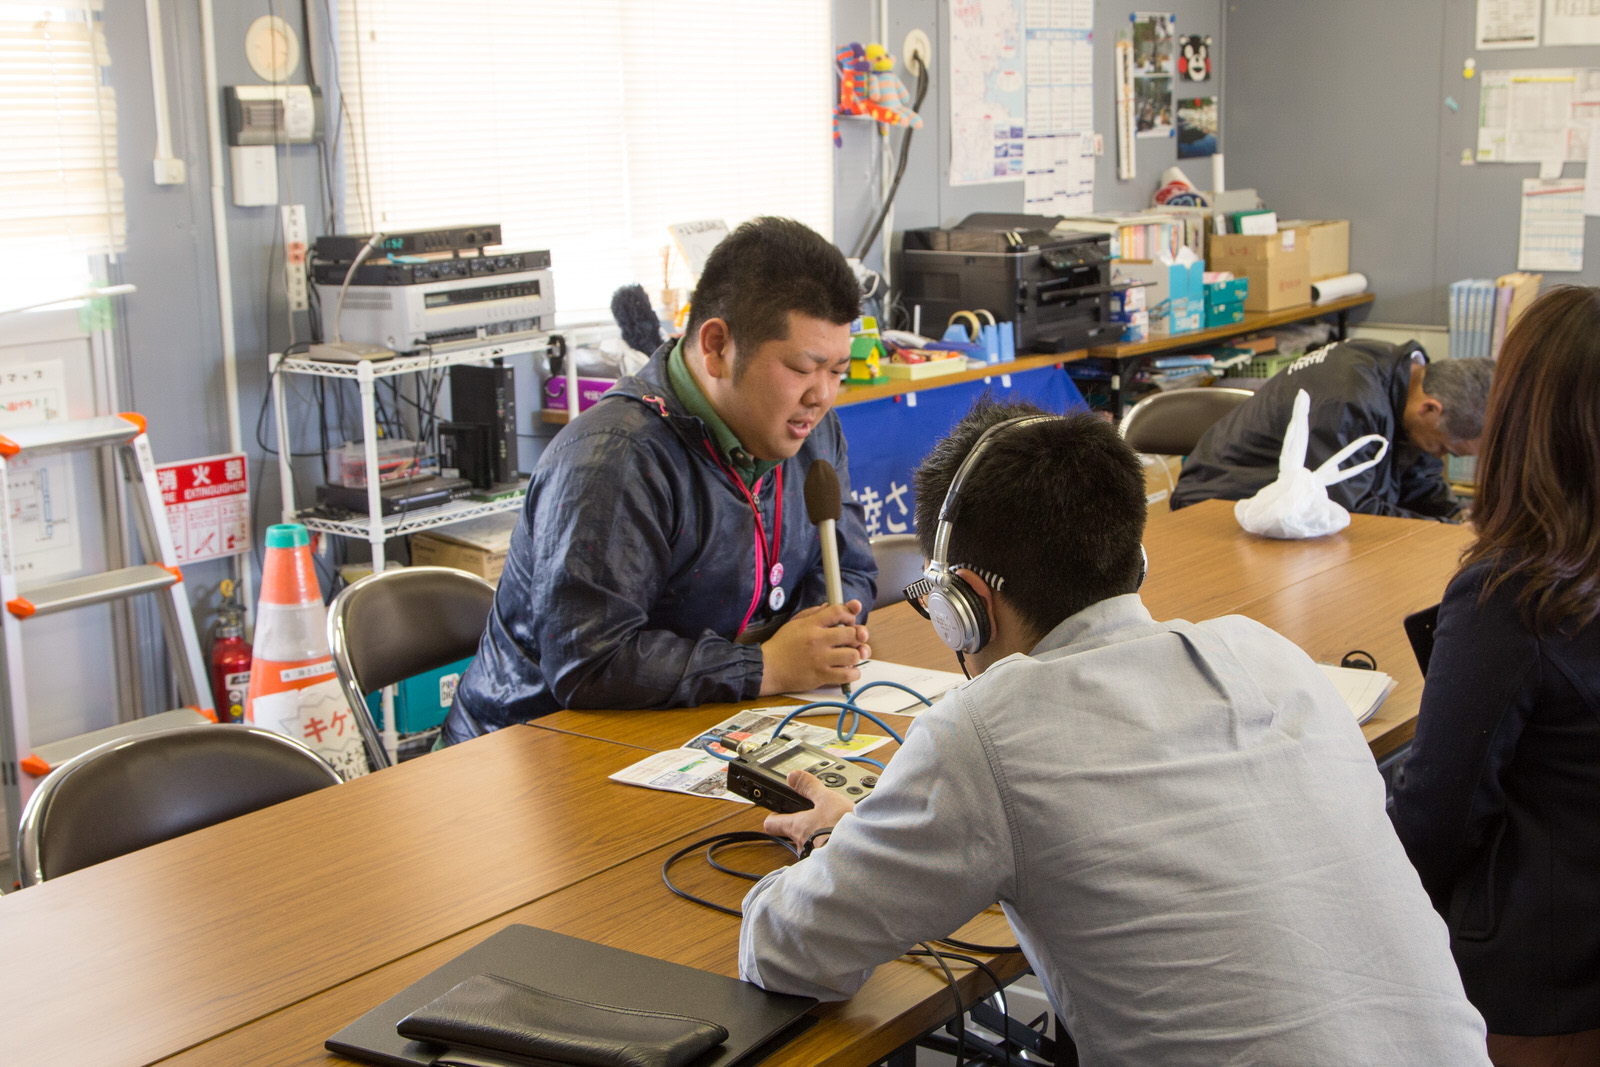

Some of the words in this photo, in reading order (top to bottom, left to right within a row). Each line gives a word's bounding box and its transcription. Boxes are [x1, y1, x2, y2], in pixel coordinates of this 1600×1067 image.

[157, 459, 244, 491] 消火器
[184, 480, 246, 500] EXTINGUISHER
